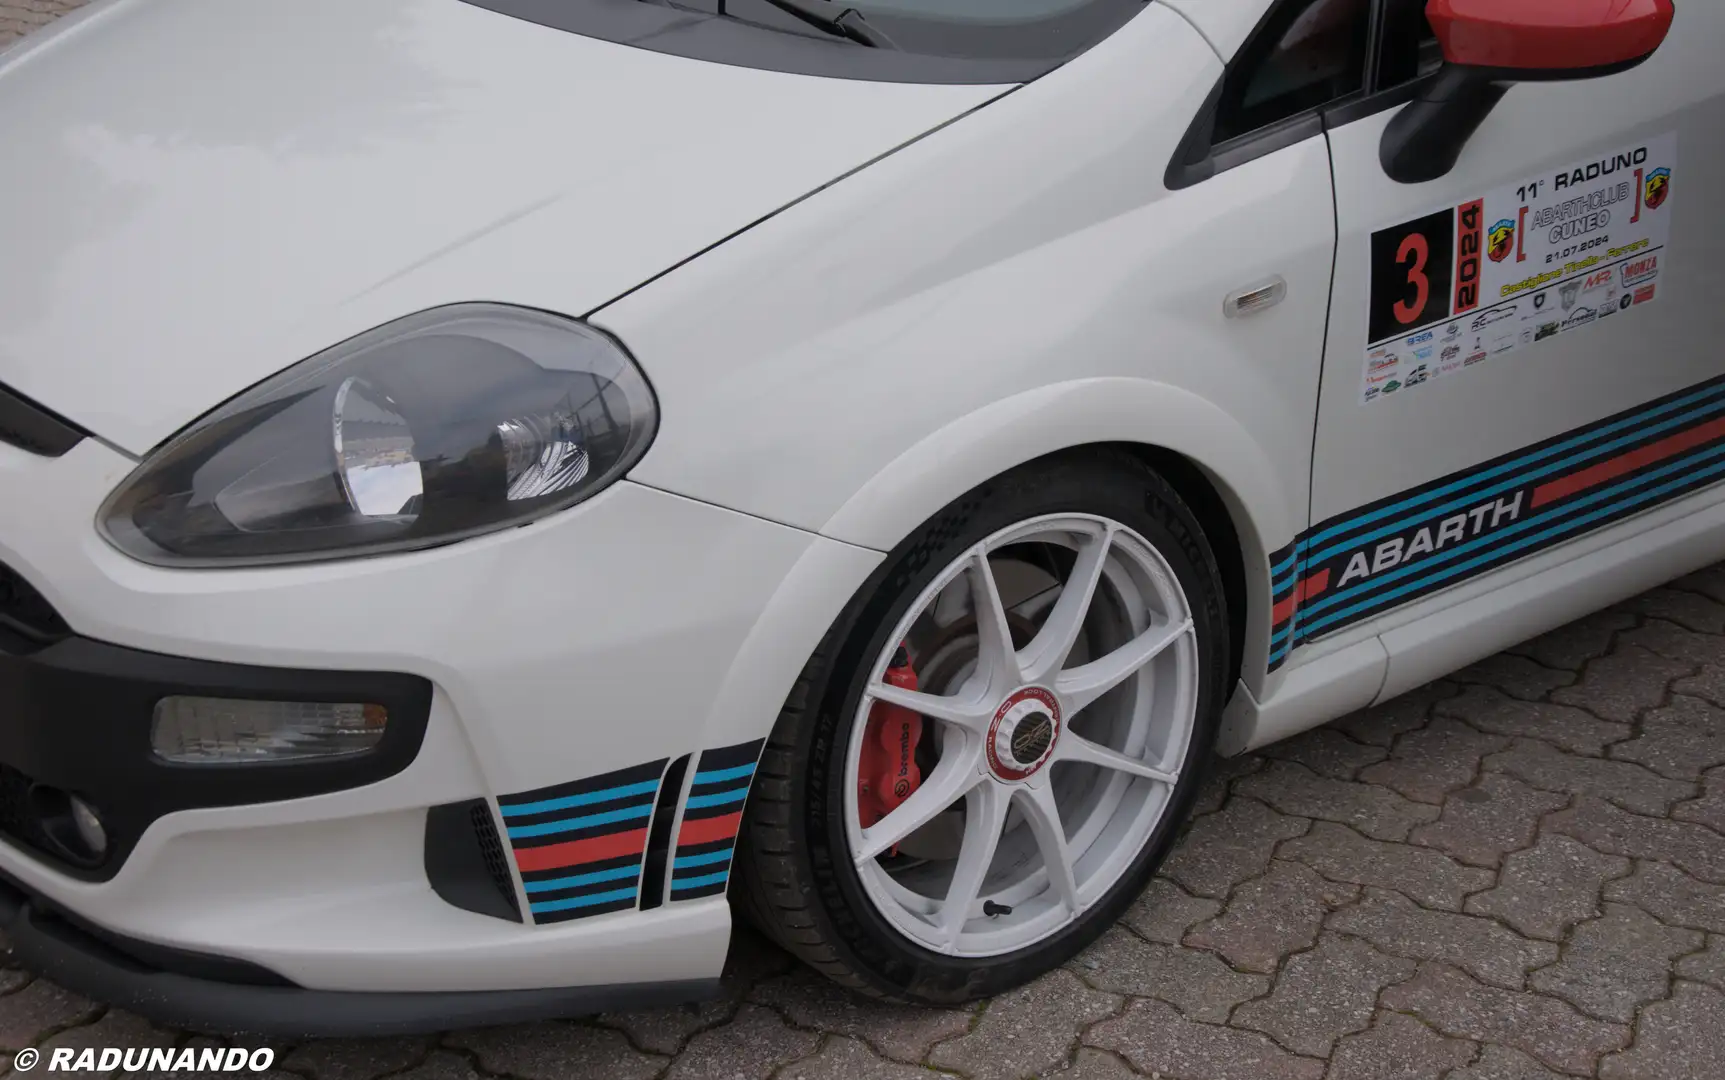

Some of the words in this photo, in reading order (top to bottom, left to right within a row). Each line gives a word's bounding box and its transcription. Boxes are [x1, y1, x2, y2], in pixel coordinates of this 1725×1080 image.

[1554, 146, 1648, 191] RADUNO
[1530, 181, 1630, 231] ABARTHCLUB
[1548, 208, 1611, 245] CUNEO
[1457, 203, 1481, 309] 2024
[1545, 234, 1609, 264] 21.07.2024
[1392, 232, 1430, 325] 3
[1336, 490, 1524, 588] ABARTH
[899, 722, 910, 776] brembo
